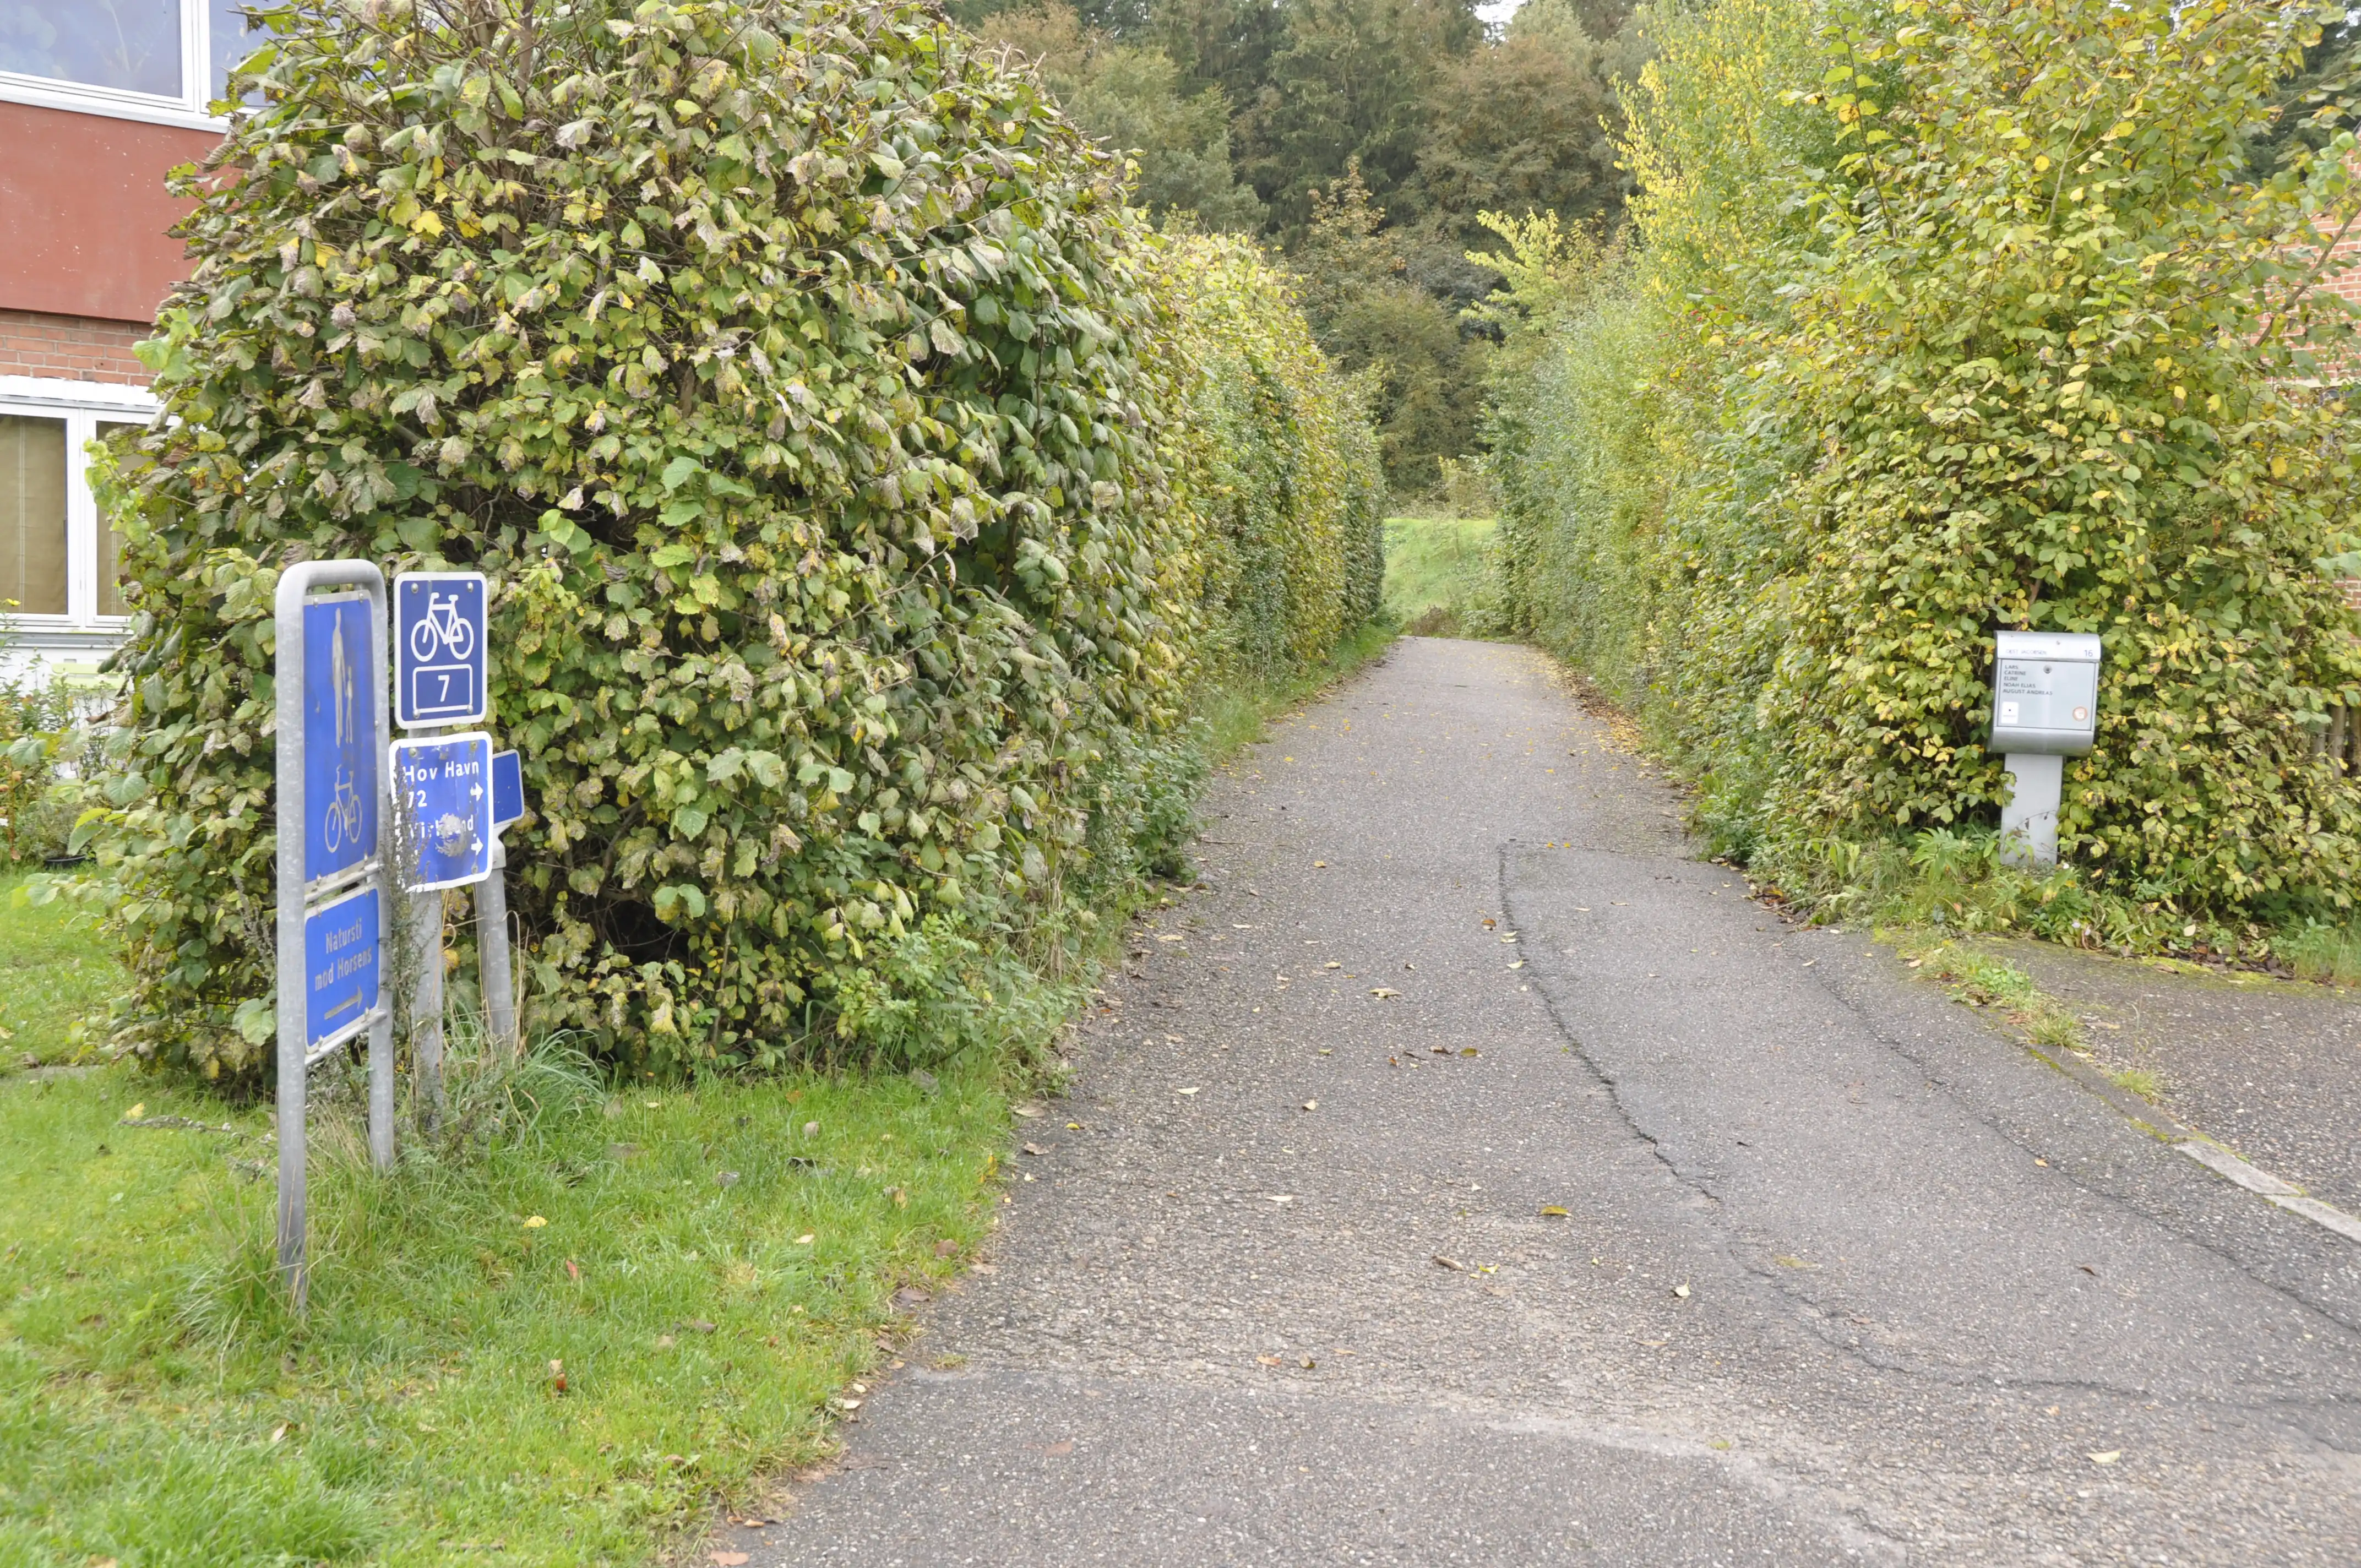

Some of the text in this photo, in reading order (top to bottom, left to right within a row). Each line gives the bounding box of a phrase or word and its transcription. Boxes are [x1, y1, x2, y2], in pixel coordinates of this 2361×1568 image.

[438, 674, 450, 703] 7
[402, 761, 479, 782] Hov Havn
[325, 917, 362, 954] Natursti
[315, 946, 372, 992] mod Horsens
